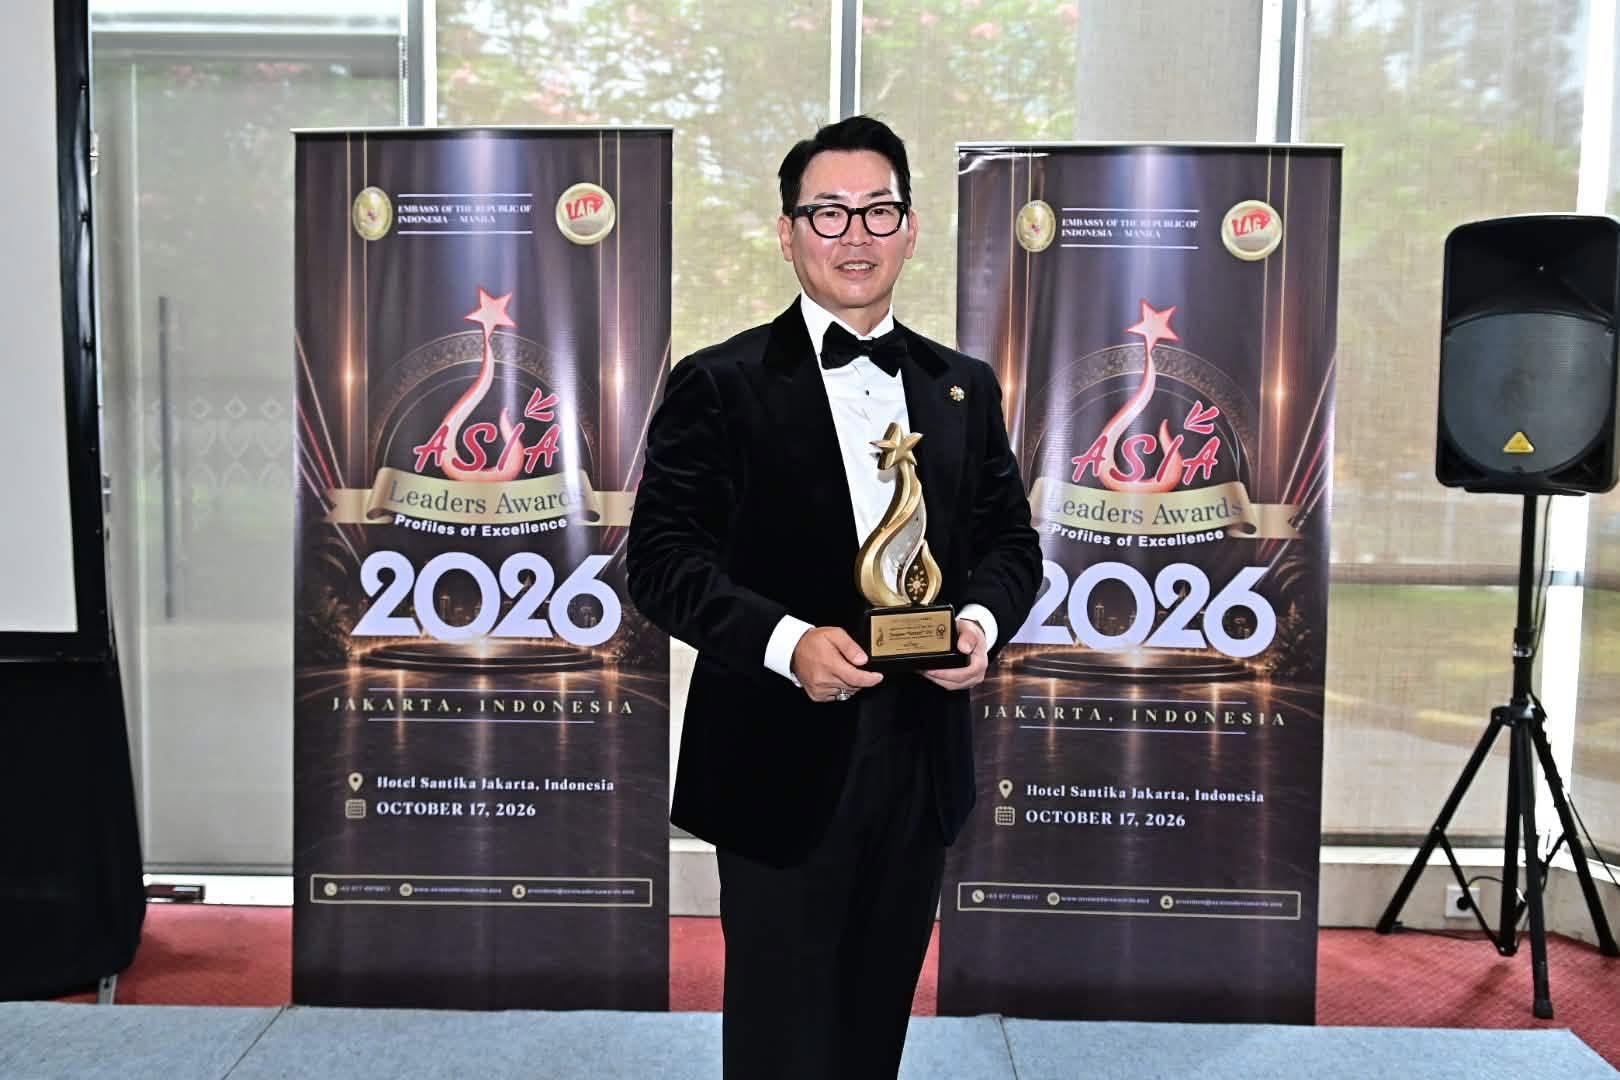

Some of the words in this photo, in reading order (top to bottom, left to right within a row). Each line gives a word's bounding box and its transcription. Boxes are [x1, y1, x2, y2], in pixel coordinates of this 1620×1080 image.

[398, 204, 440, 214] EMBASSY
[441, 204, 453, 214] OF
[520, 205, 533, 214] OF
[398, 215, 448, 224] INDONESIA
[1061, 218, 1105, 228] EMBASSY
[1106, 218, 1118, 228] OF
[1185, 219, 1199, 229] OF
[1061, 229, 1113, 238] INDONESIA
[413, 422, 561, 473] ASIA
[1071, 434, 1221, 485] ASIA
[389, 480, 487, 514] Leaders
[1049, 500, 1144, 526] eaders
[1152, 496, 1244, 526] Awards
[394, 514, 456, 536] Profiles
[460, 524, 477, 537] of
[481, 516, 569, 538] Excellence
[1051, 523, 1112, 546] Profiles
[1116, 532, 1133, 546] of
[1138, 529, 1226, 549] Excellence
[351, 550, 623, 648] 2026
[1008, 559, 1276, 659] 2026
[331, 696, 464, 714] JAKARTA,
[479, 699, 634, 715] INDONESIA
[983, 704, 1115, 723] JAKARTA,
[1131, 708, 1285, 727] INDONESIA
[376, 776, 416, 790] Hotel
[420, 776, 477, 790] Santika
[481, 777, 541, 792] Jakarta,
[544, 778, 615, 792] Indonesia
[1026, 784, 1066, 798] Hotel
[1070, 785, 1126, 799] Santika
[1131, 786, 1191, 802] Jakarta,
[1195, 789, 1265, 804] Indonesia
[376, 801, 464, 817] OCTOBER
[469, 803, 491, 819] 17,
[495, 803, 537, 818] 2026
[1025, 809, 1112, 826] OCTOBER
[1119, 812, 1140, 828] 17,
[1144, 814, 1186, 828] 2026
